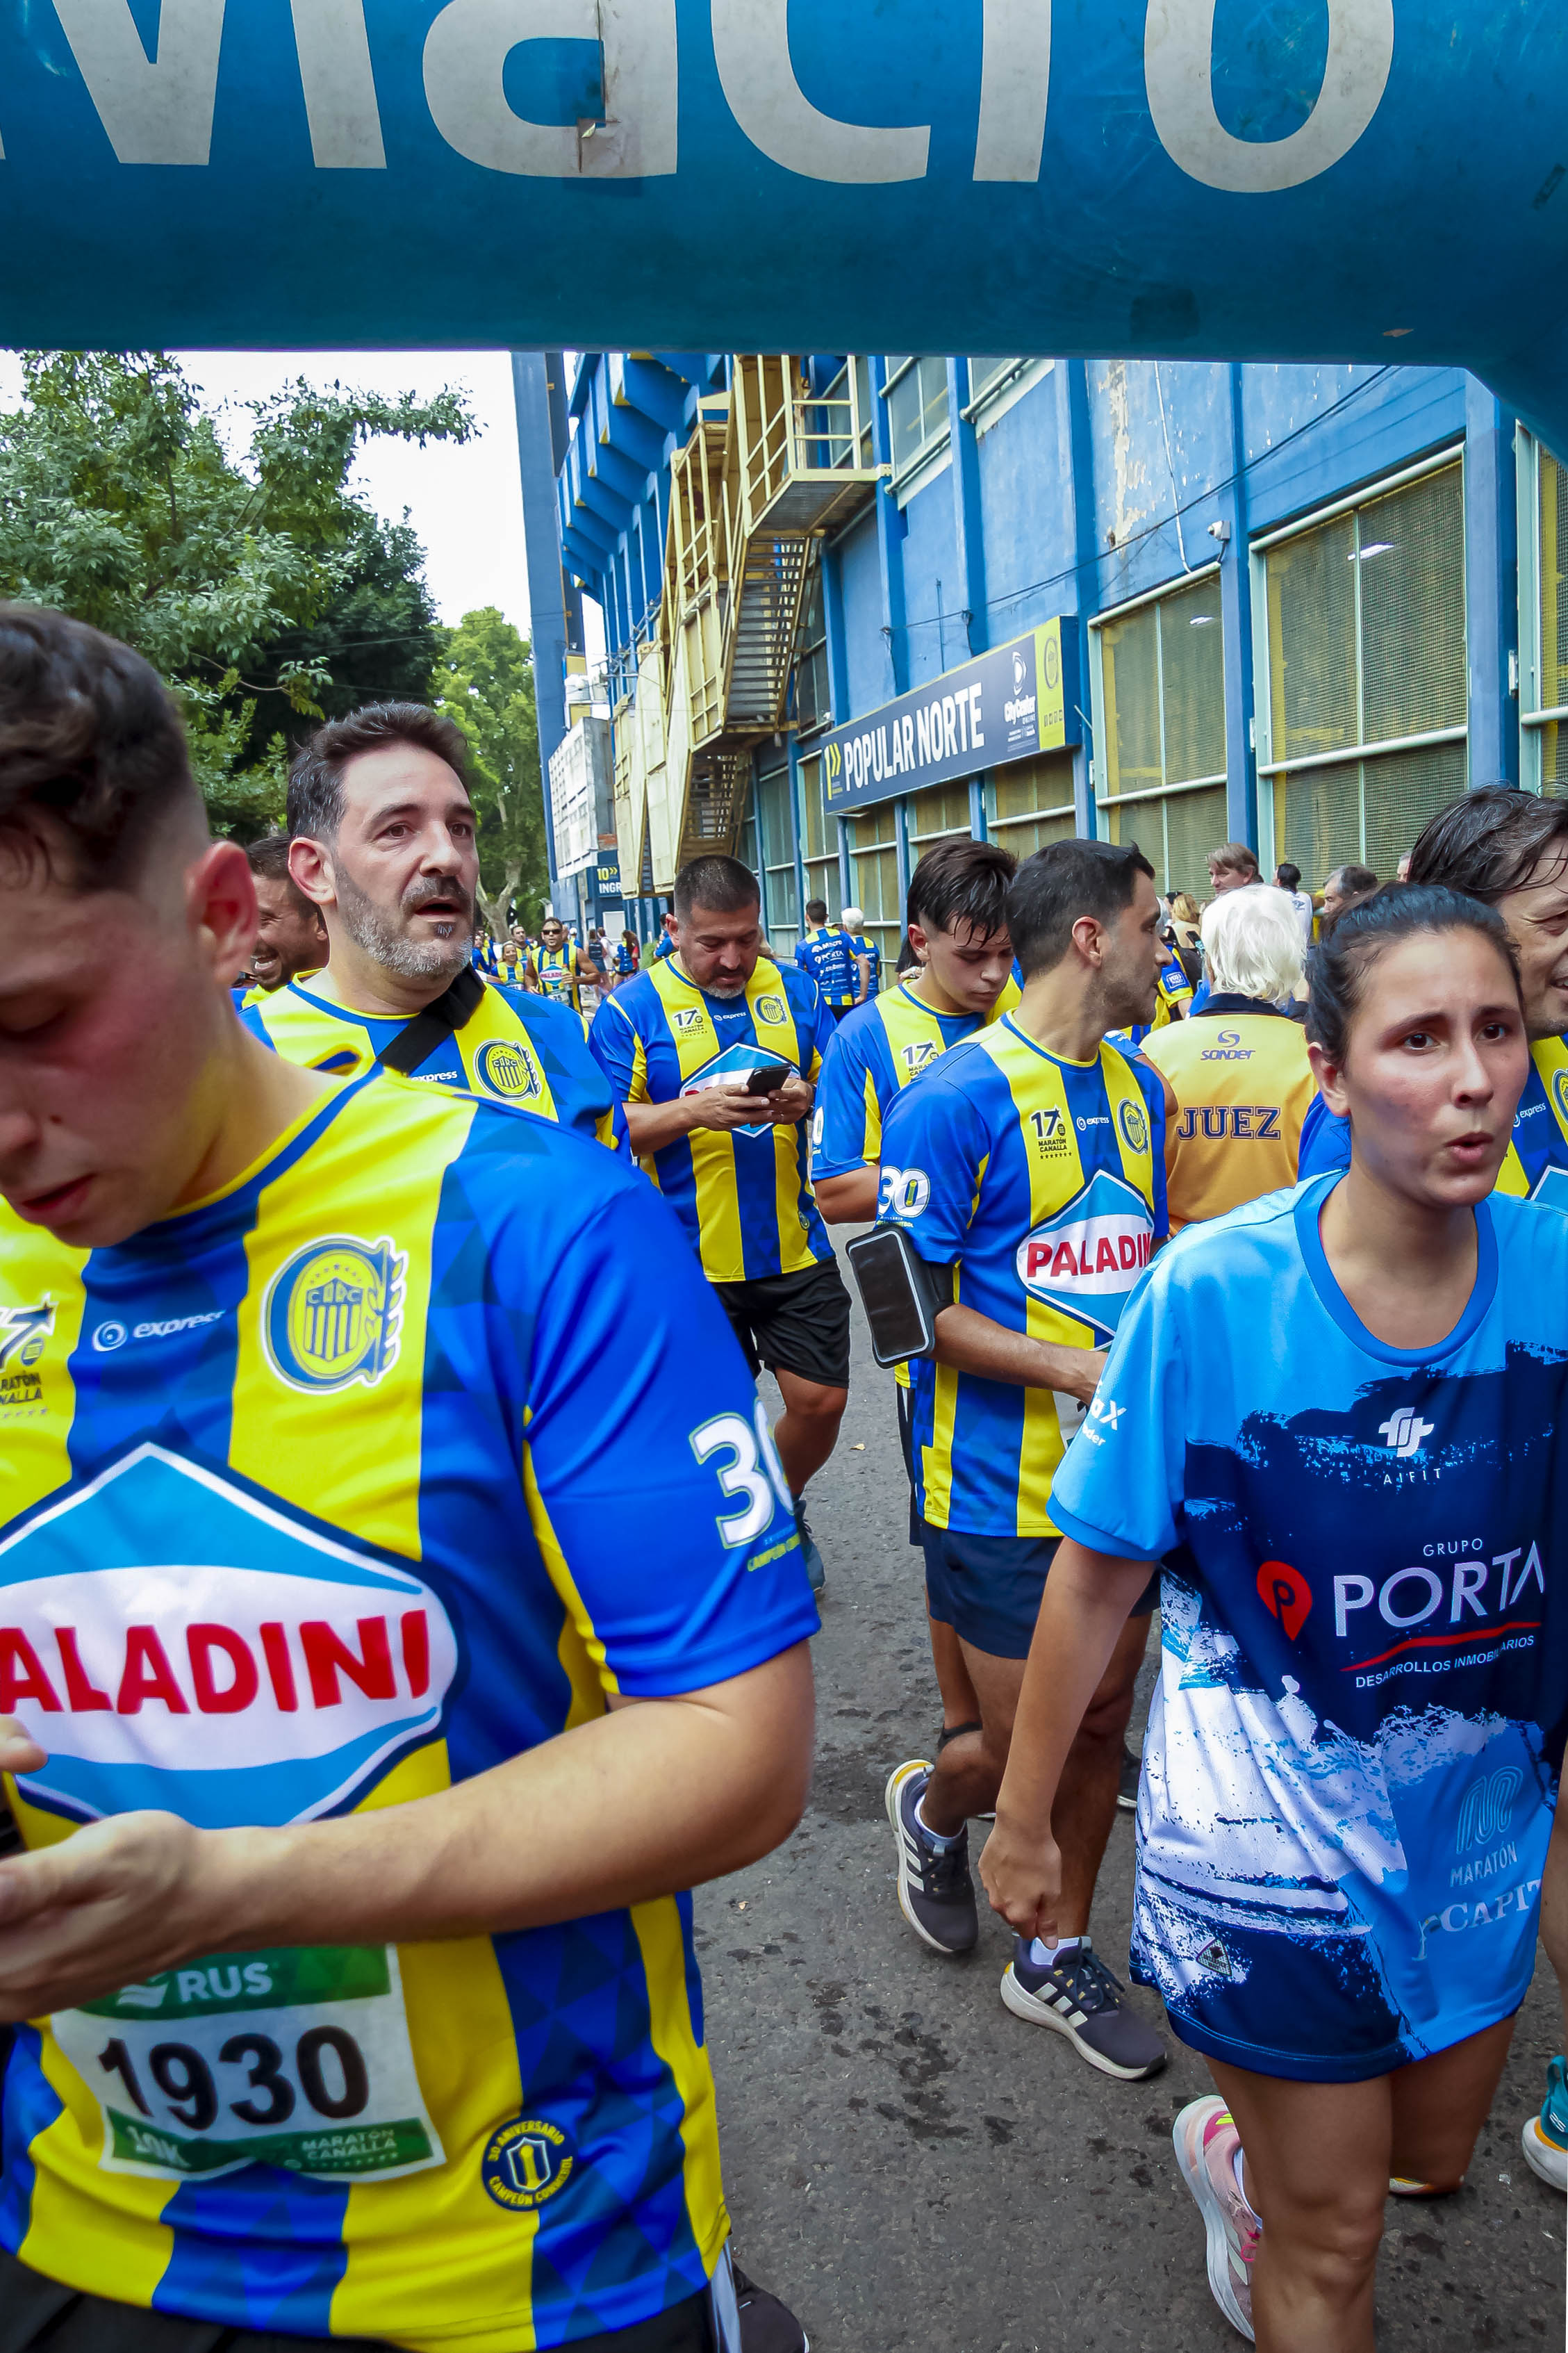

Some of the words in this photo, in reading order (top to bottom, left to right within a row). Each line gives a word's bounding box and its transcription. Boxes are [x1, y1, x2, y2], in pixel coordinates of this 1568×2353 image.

[843, 714, 914, 792] POPULAR
[916, 682, 985, 767] NORTE
[597, 867, 609, 881] 10
[493, 1056, 518, 1067] CARC
[902, 1042, 935, 1065] 17
[1031, 1109, 1062, 1138] 17
[1086, 1116, 1109, 1126] express
[1176, 1106, 1281, 1140] JUEZ
[1519, 1102, 1546, 1118] express
[1038, 1137, 1066, 1147] MARATÓN
[1039, 1144, 1067, 1152] CANALLA
[878, 1165, 930, 1218] 30
[1423, 1538, 1483, 1557] GRUPO
[1333, 1540, 1544, 1637] PORTA
[0, 1609, 430, 1714] ALADINI
[1356, 1659, 1451, 1689] DESARROLLOS
[1451, 1841, 1517, 1887] MARATÓN
[178, 1962, 272, 2001] RUS
[99, 2024, 370, 2131] 1930
[302, 2129, 395, 2151] MARATÓN
[496, 2120, 565, 2146] ANIVERSARIO
[307, 2140, 397, 2159] CANALLA
[489, 2175, 534, 2206] CAMPEÓN
